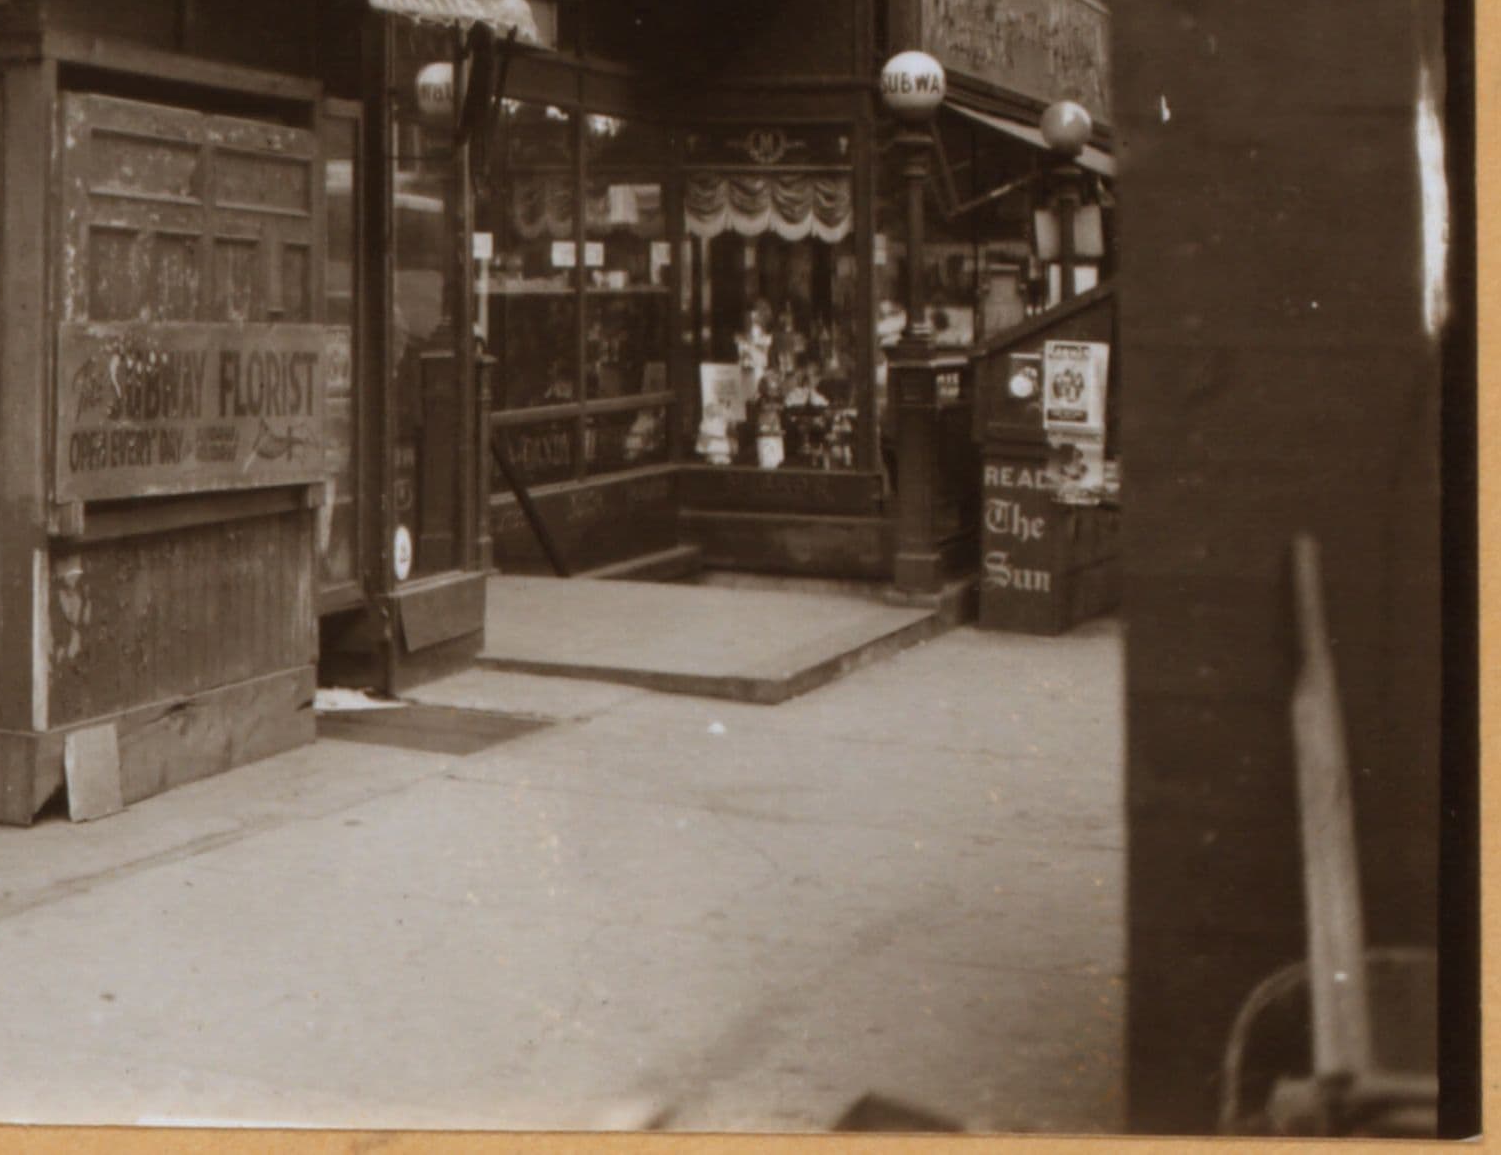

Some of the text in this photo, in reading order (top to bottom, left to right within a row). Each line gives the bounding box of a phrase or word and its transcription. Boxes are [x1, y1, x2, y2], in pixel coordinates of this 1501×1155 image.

[218, 350, 319, 418] FLORIST
[984, 498, 1046, 544] The
[984, 550, 1053, 595] Sun
